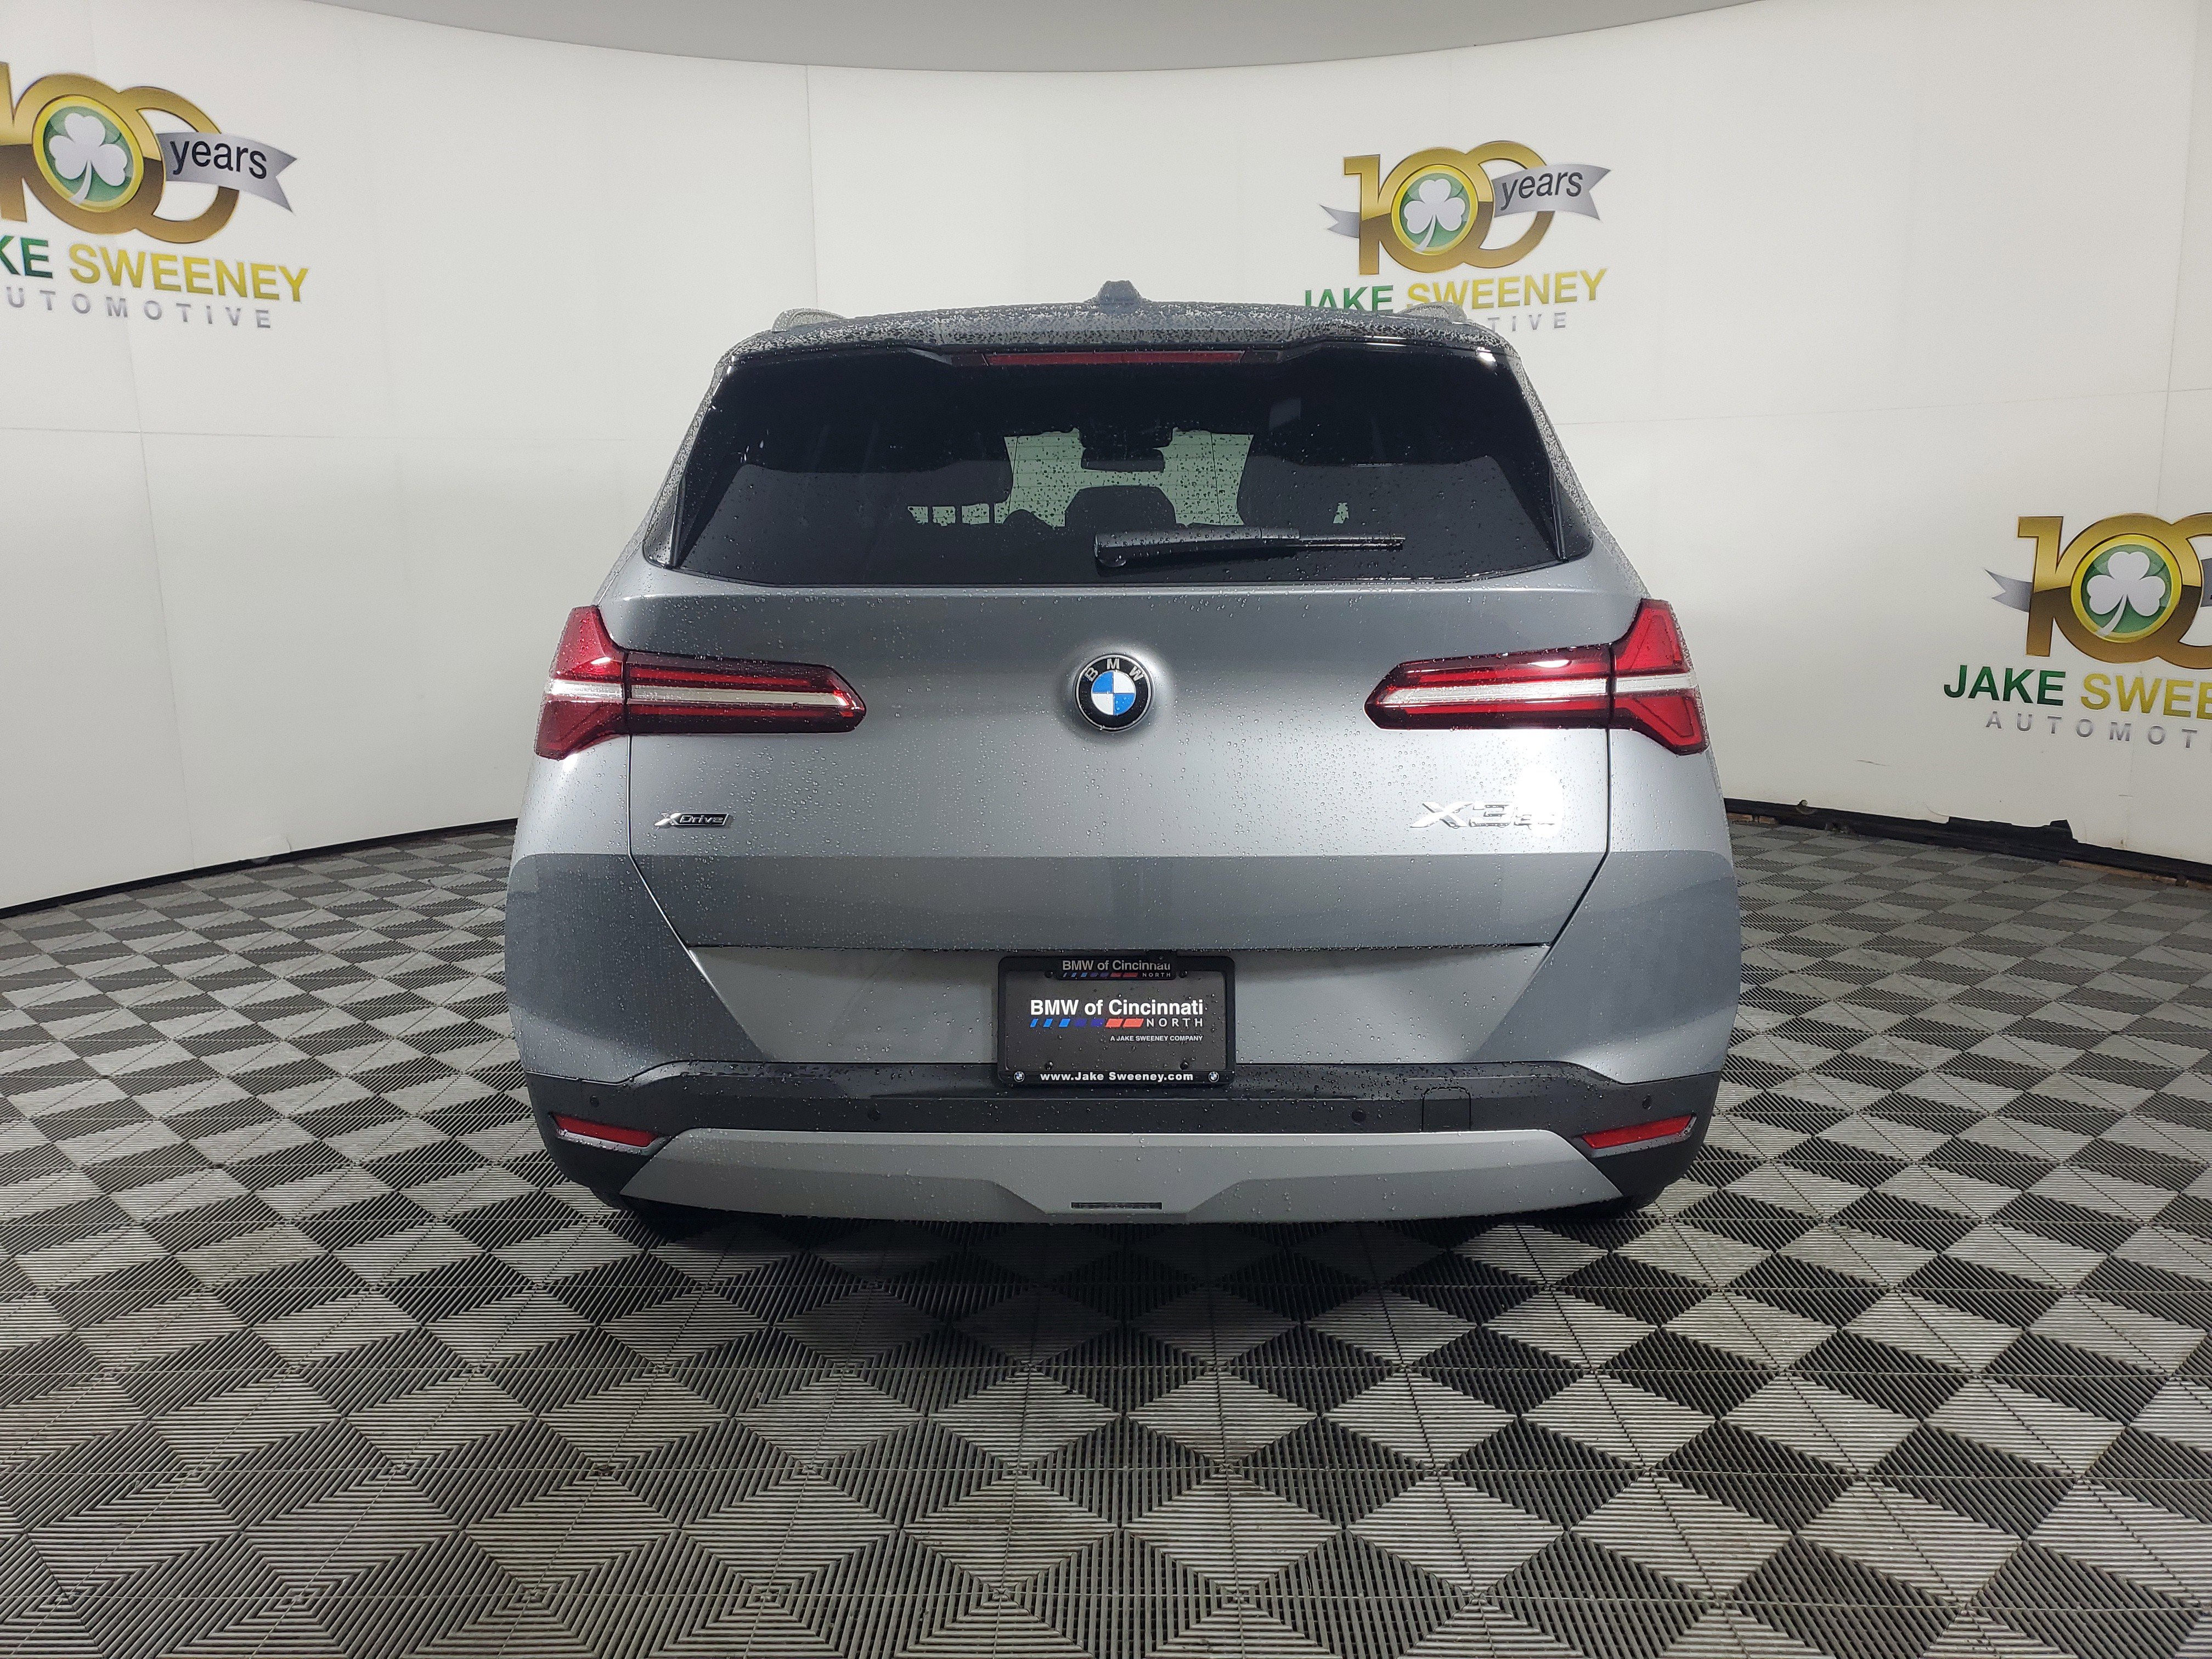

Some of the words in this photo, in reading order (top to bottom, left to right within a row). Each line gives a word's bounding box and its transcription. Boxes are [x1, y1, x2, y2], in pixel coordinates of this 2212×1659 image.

[170, 140, 267, 179] years
[1500, 168, 1583, 211] years
[69, 243, 308, 302] SWEENEY
[1084, 658, 1144, 682] BMW
[1943, 664, 2066, 706] JAKE
[1062, 960, 1094, 970] BMW
[1097, 960, 1109, 970] of
[1030, 1000, 1079, 1015] BMW
[1084, 999, 1104, 1015] of
[1109, 999, 1204, 1015] Cincinnati
[1146, 1018, 1203, 1027] NORTH
[1040, 1072, 1104, 1081] www.Jake
[1109, 1072, 1194, 1082] Sweeney.com
